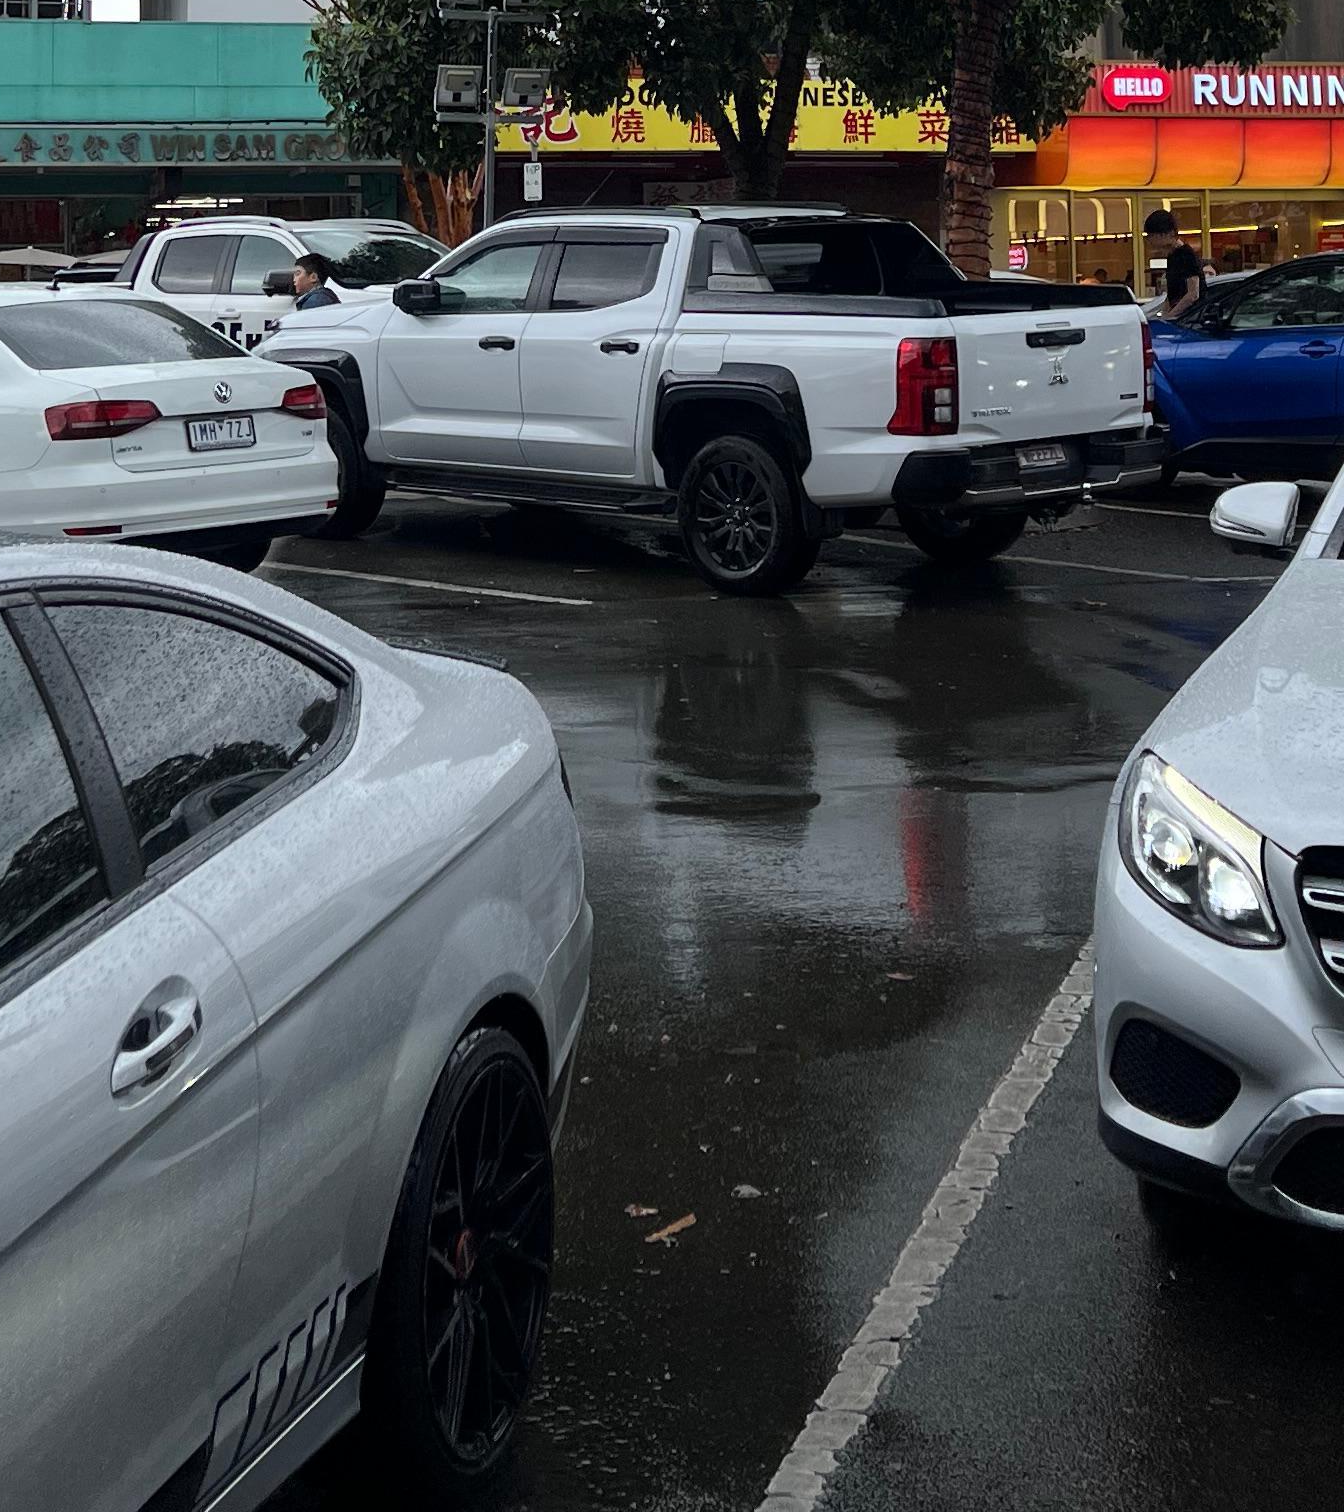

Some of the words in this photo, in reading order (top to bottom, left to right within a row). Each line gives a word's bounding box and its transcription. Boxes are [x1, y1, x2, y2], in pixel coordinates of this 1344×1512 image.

[1113, 78, 1164, 97] HELLO
[150, 133, 206, 162] WIN
[213, 133, 276, 162] SAM
[191, 424, 216, 442] 1MH
[225, 419, 253, 439] 7ZJ
